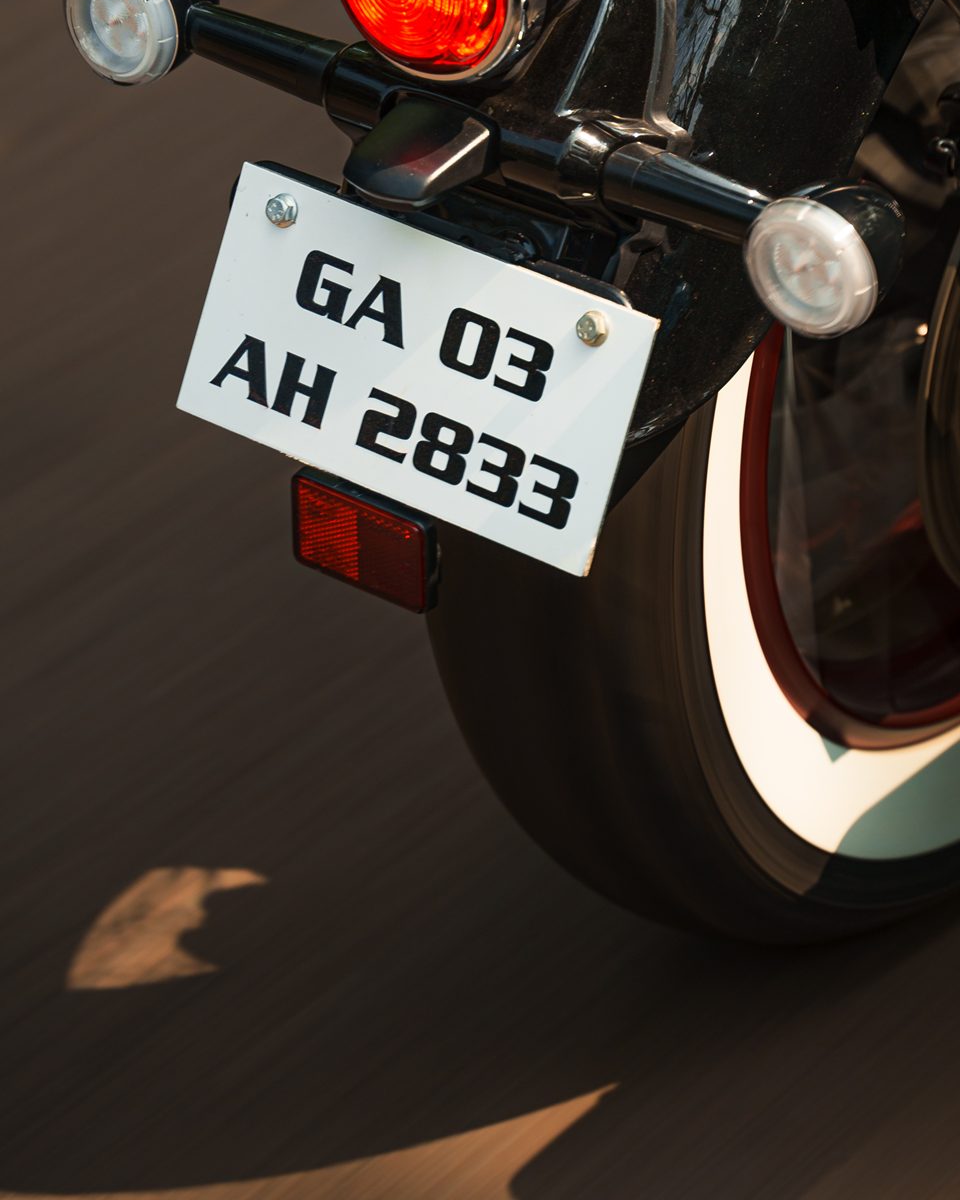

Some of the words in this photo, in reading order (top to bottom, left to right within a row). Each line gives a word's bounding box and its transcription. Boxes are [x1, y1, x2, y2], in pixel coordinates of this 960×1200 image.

[295, 249, 405, 350] GA
[439, 307, 555, 403] 03
[209, 334, 338, 431] AH
[355, 387, 580, 531] 2833
